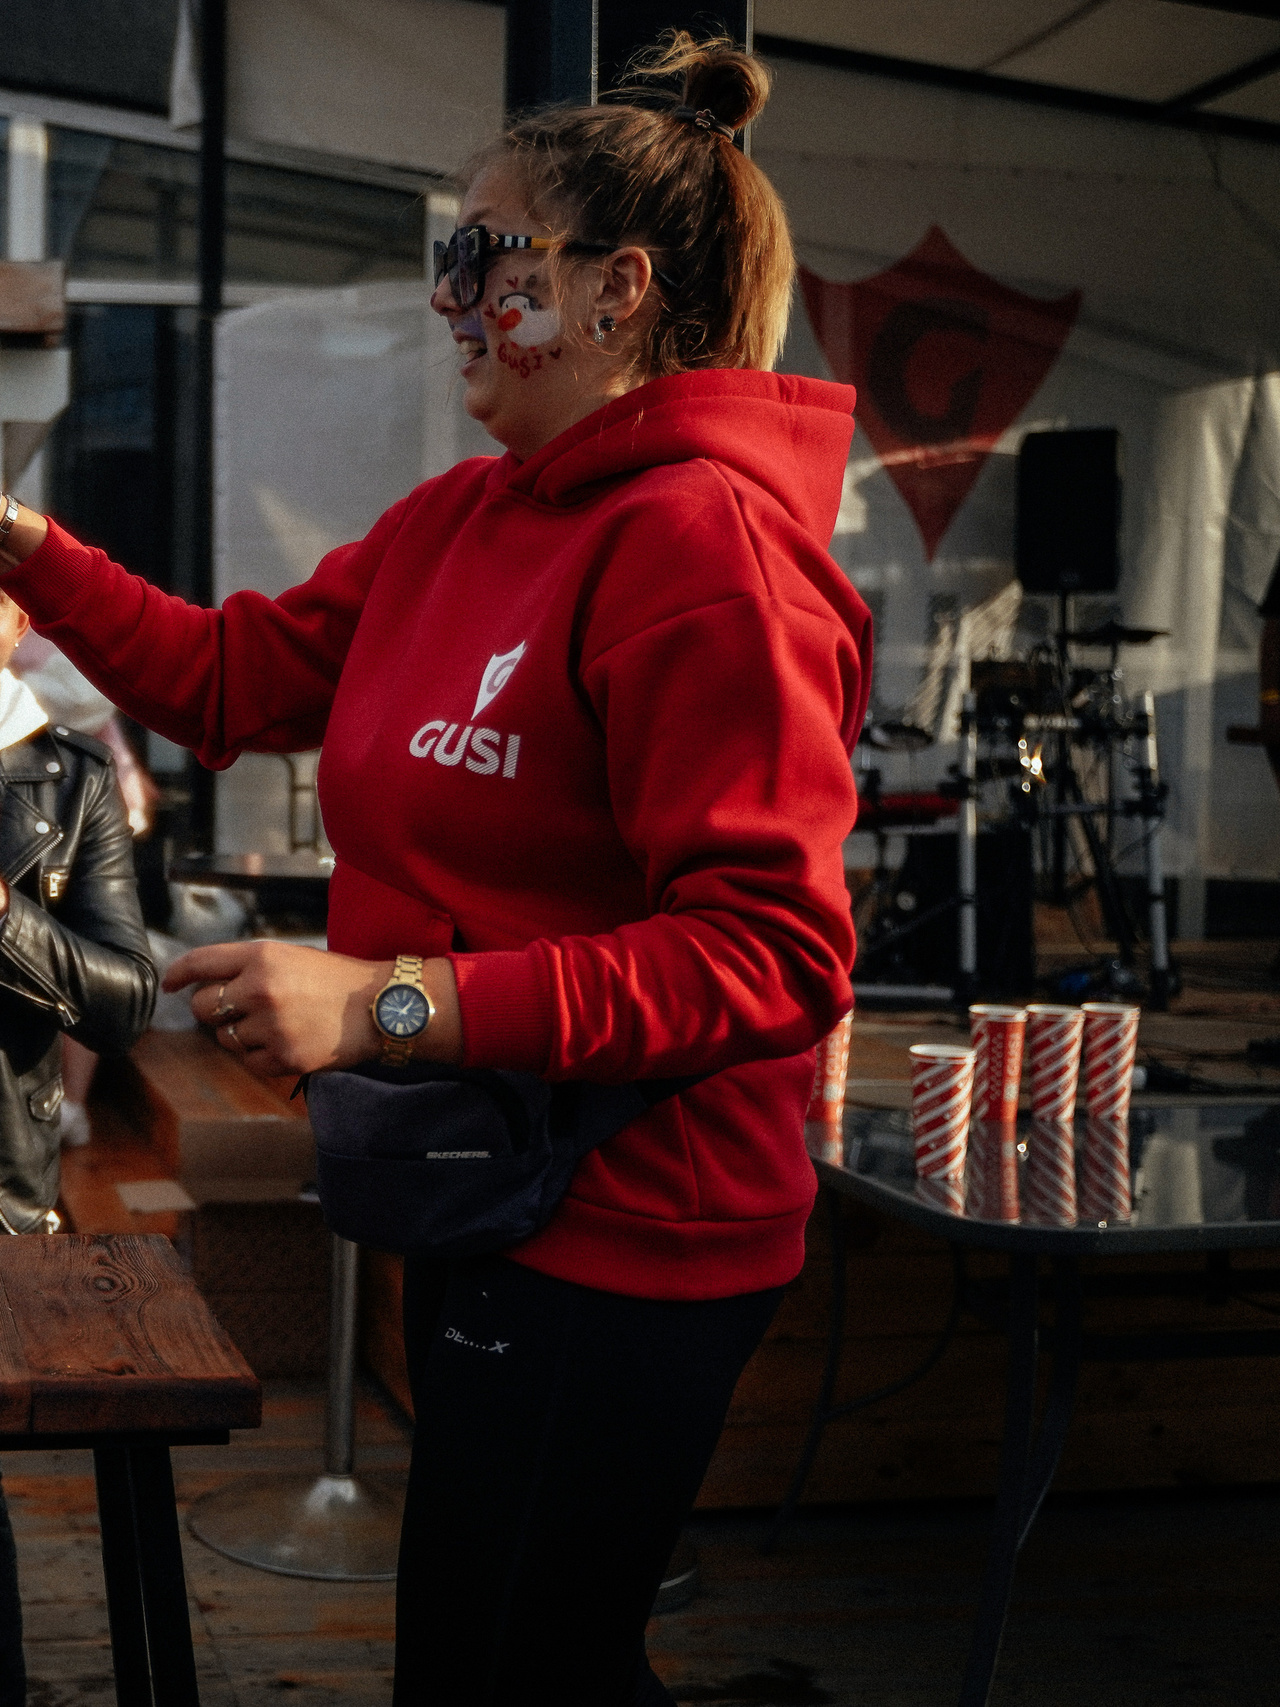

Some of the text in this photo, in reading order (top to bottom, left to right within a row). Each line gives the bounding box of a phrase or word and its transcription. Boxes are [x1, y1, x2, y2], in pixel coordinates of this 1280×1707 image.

[866, 302, 990, 445] G
[408, 719, 521, 780] GUSI
[425, 1150, 490, 1160] SKECHERS
[444, 1326, 511, 1354] DEX
